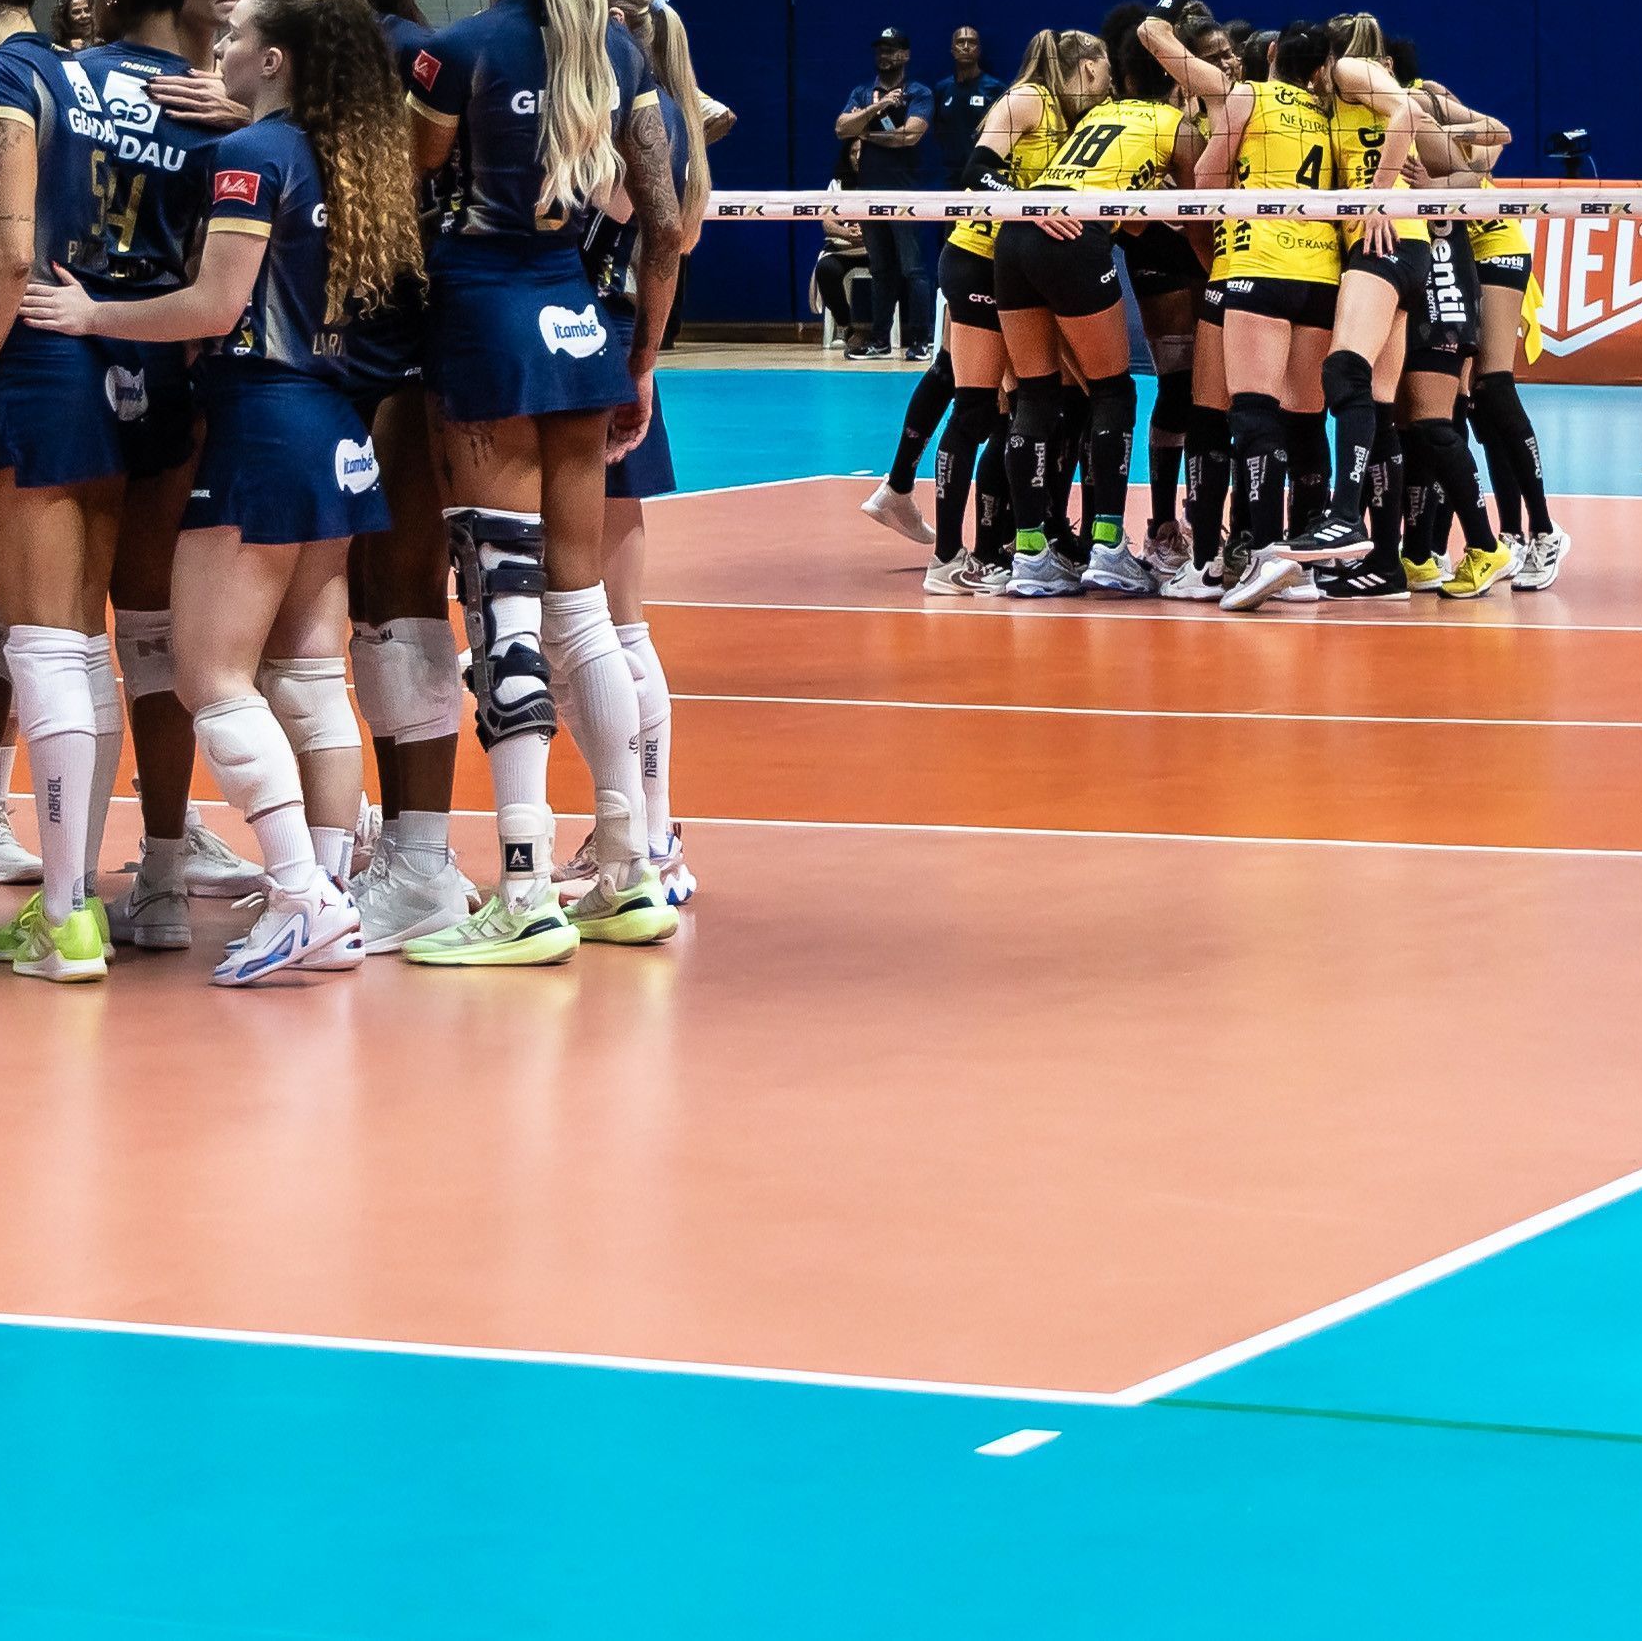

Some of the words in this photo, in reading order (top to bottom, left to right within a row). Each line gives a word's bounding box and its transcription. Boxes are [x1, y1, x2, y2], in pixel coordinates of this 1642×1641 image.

[1059, 124, 1127, 168] 18
[1296, 144, 1324, 190] 4
[718, 205, 765, 217] BET7K
[868, 205, 916, 217] BET7K
[1021, 205, 1070, 217] BET7K
[1177, 204, 1226, 216] BET7K
[1336, 204, 1387, 216] BET7K
[1498, 203, 1551, 216] BET7K
[552, 315, 598, 342] itambé
